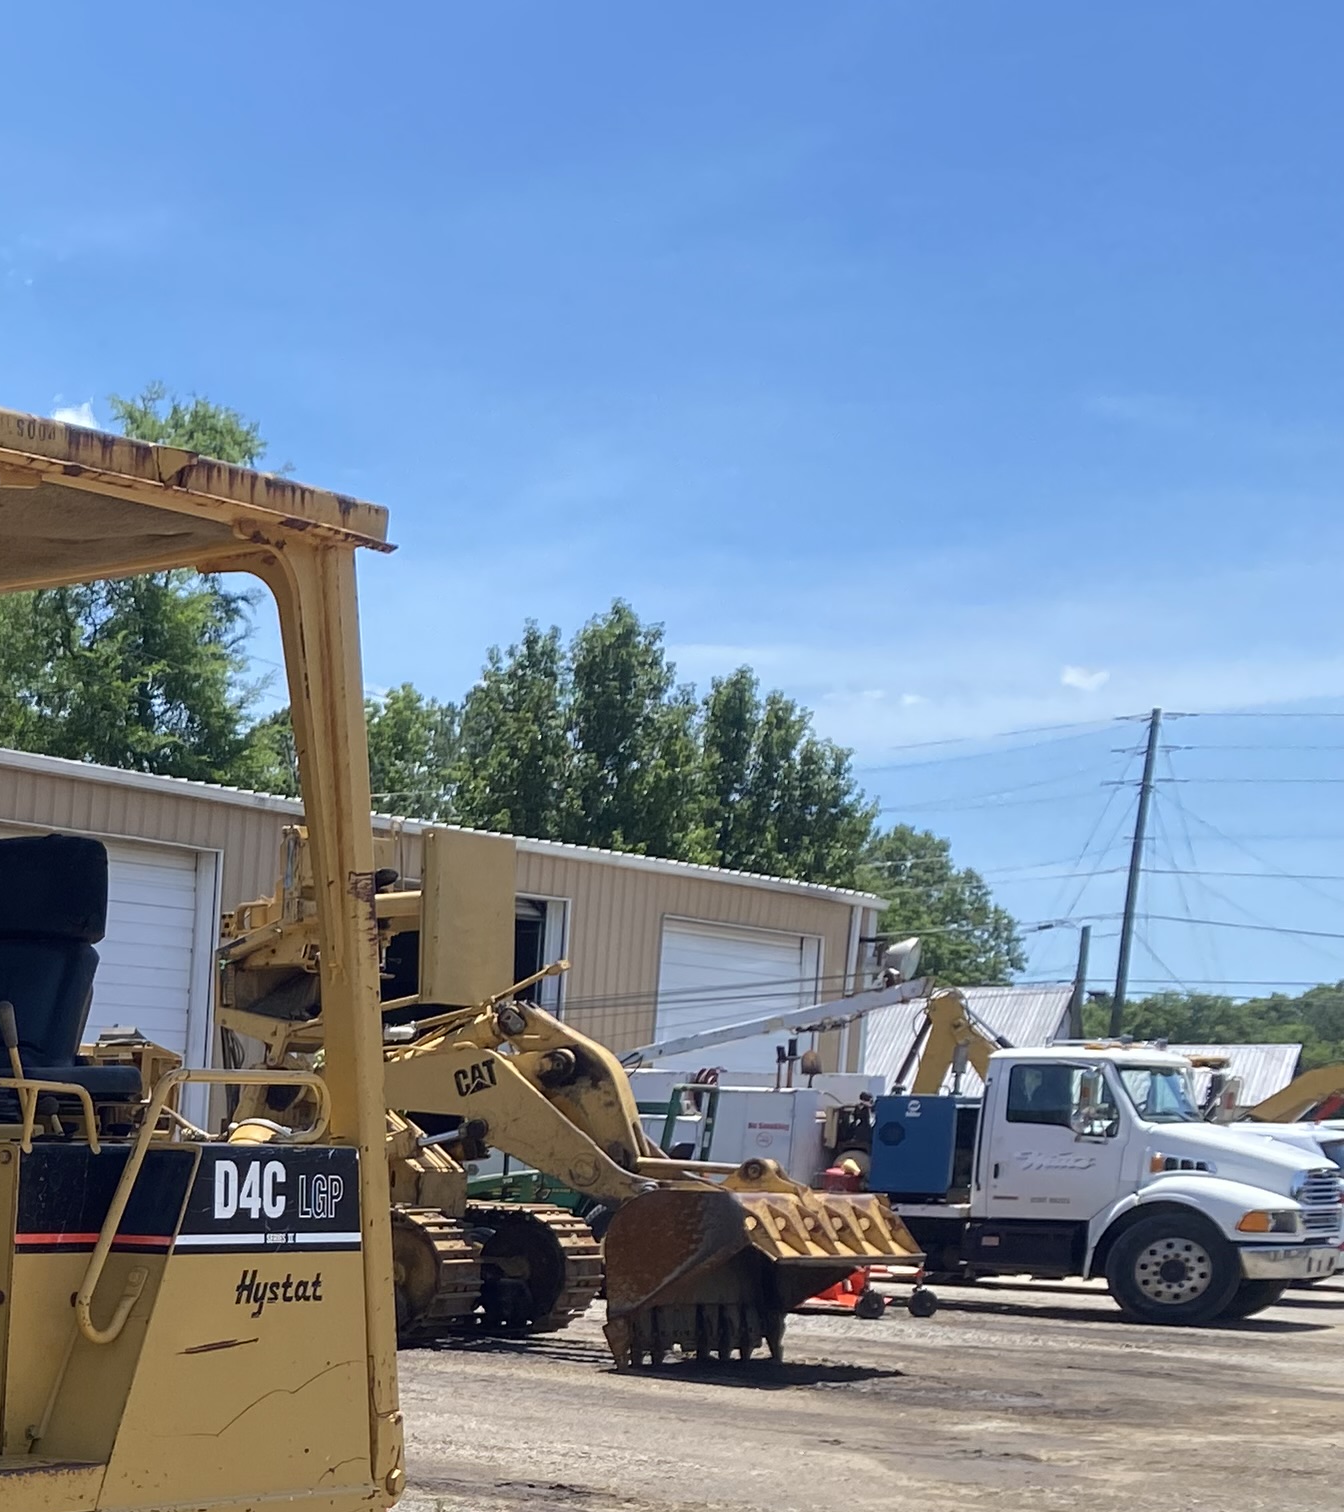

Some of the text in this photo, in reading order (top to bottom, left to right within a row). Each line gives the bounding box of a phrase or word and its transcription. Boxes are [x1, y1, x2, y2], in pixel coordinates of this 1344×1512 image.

[454, 1058, 497, 1097] CAT
[214, 1160, 344, 1219] D4C LGP
[235, 1269, 323, 1318] Hystat
